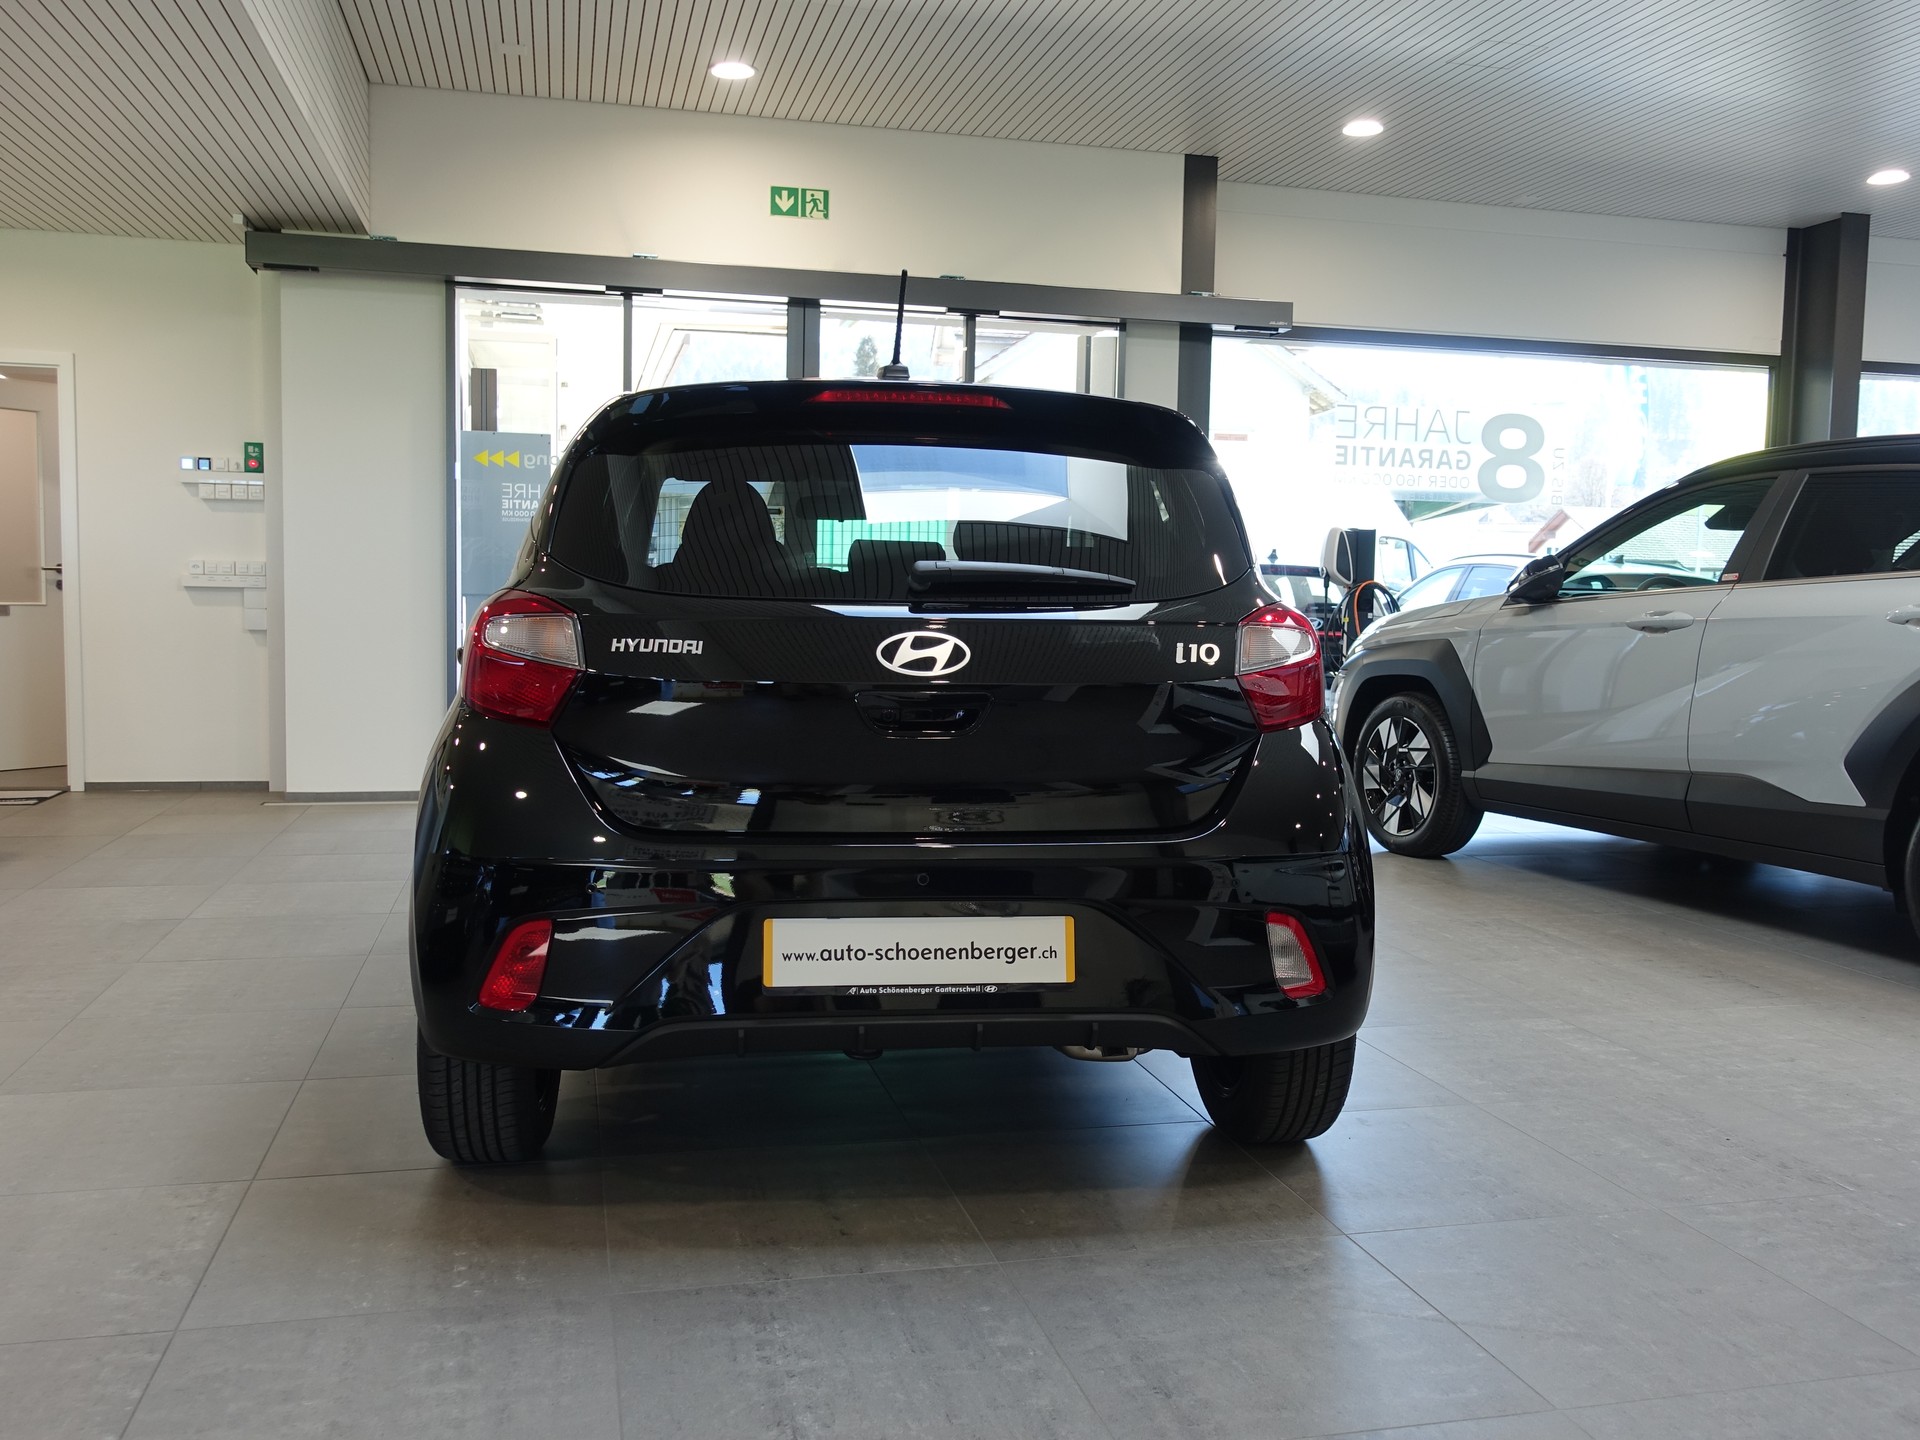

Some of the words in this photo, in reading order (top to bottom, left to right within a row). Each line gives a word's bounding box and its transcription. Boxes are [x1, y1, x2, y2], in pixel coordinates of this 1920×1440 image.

[611, 638, 704, 655] HYUNDAI
[781, 941, 1058, 965] www.auto-schoenenberger.ch
[859, 986, 877, 994] Auto
[878, 985, 934, 995] Schönenberger
[934, 985, 981, 994] Ganterschwil
